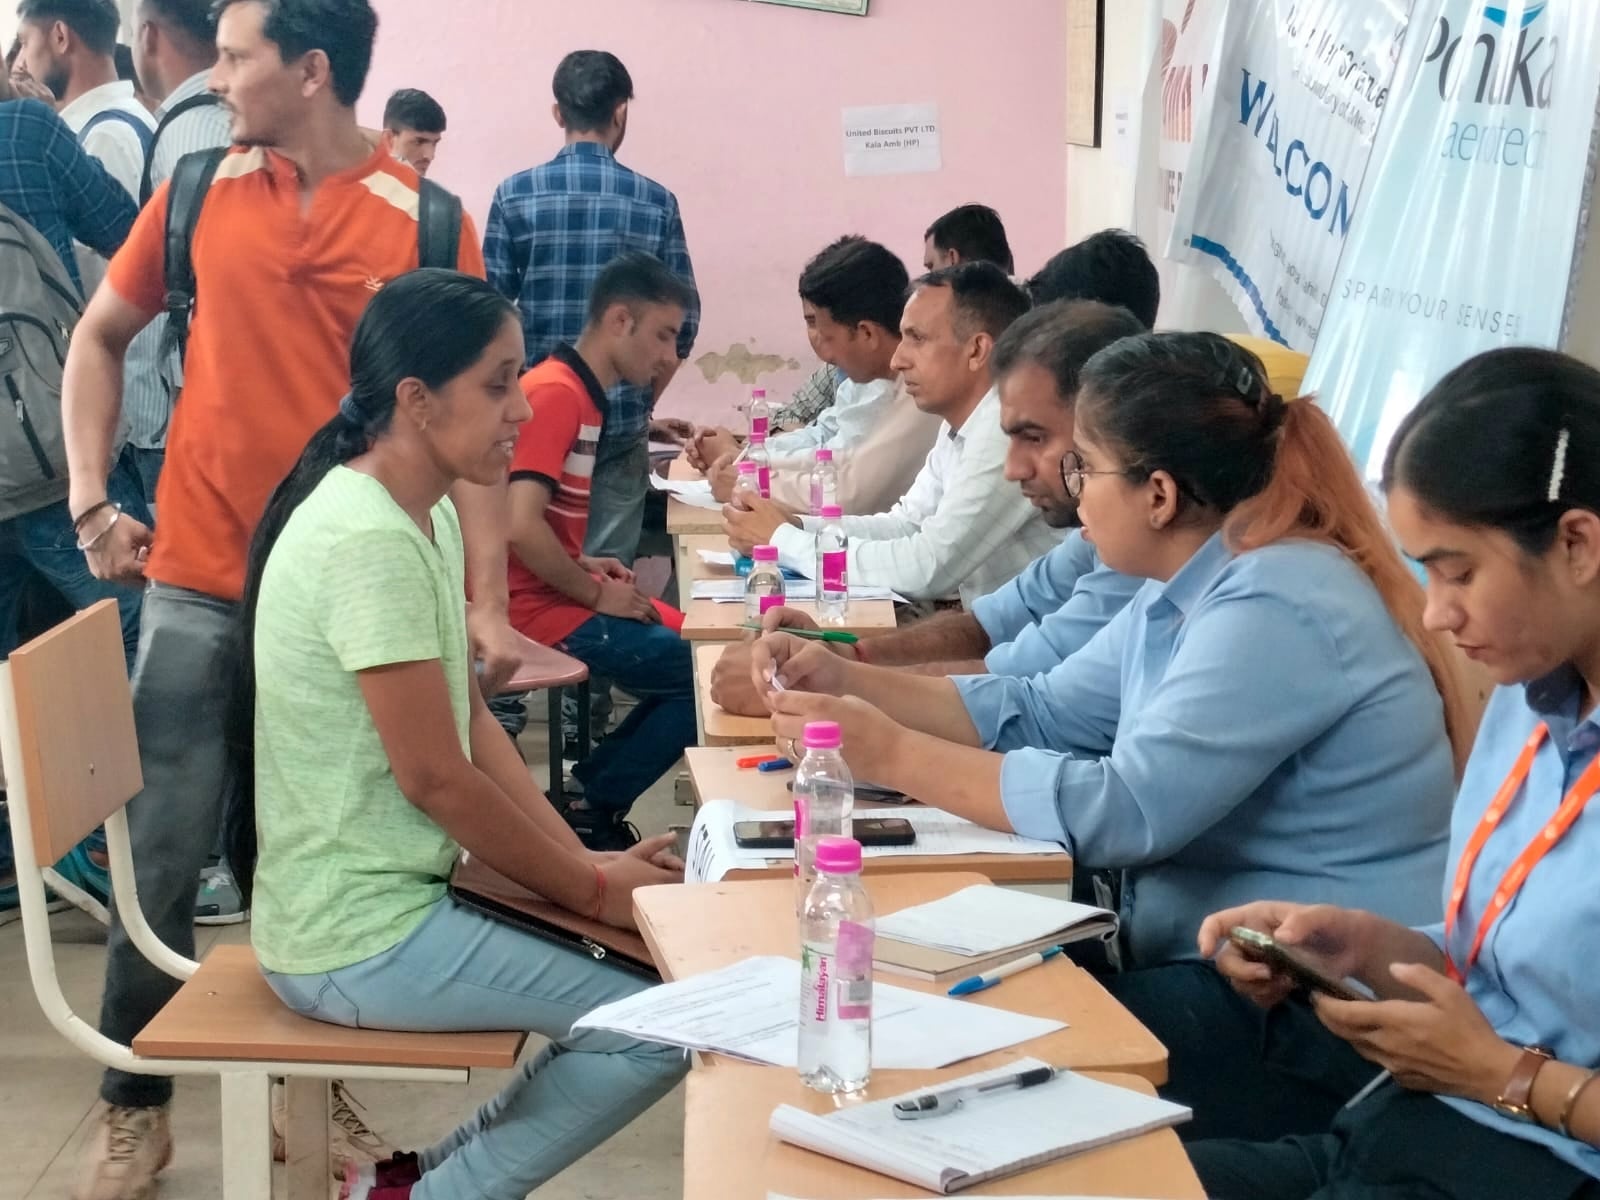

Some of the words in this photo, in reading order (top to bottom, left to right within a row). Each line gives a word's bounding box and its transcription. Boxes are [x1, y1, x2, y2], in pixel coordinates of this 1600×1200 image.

[846, 128, 872, 137] United
[873, 127, 902, 136] Biscuits
[904, 126, 918, 134] PVT
[920, 125, 935, 133] LTD
[903, 139, 920, 148] (HP)
[1400, 290, 1448, 320] YOUR
[815, 956, 829, 1021] Himalayan
